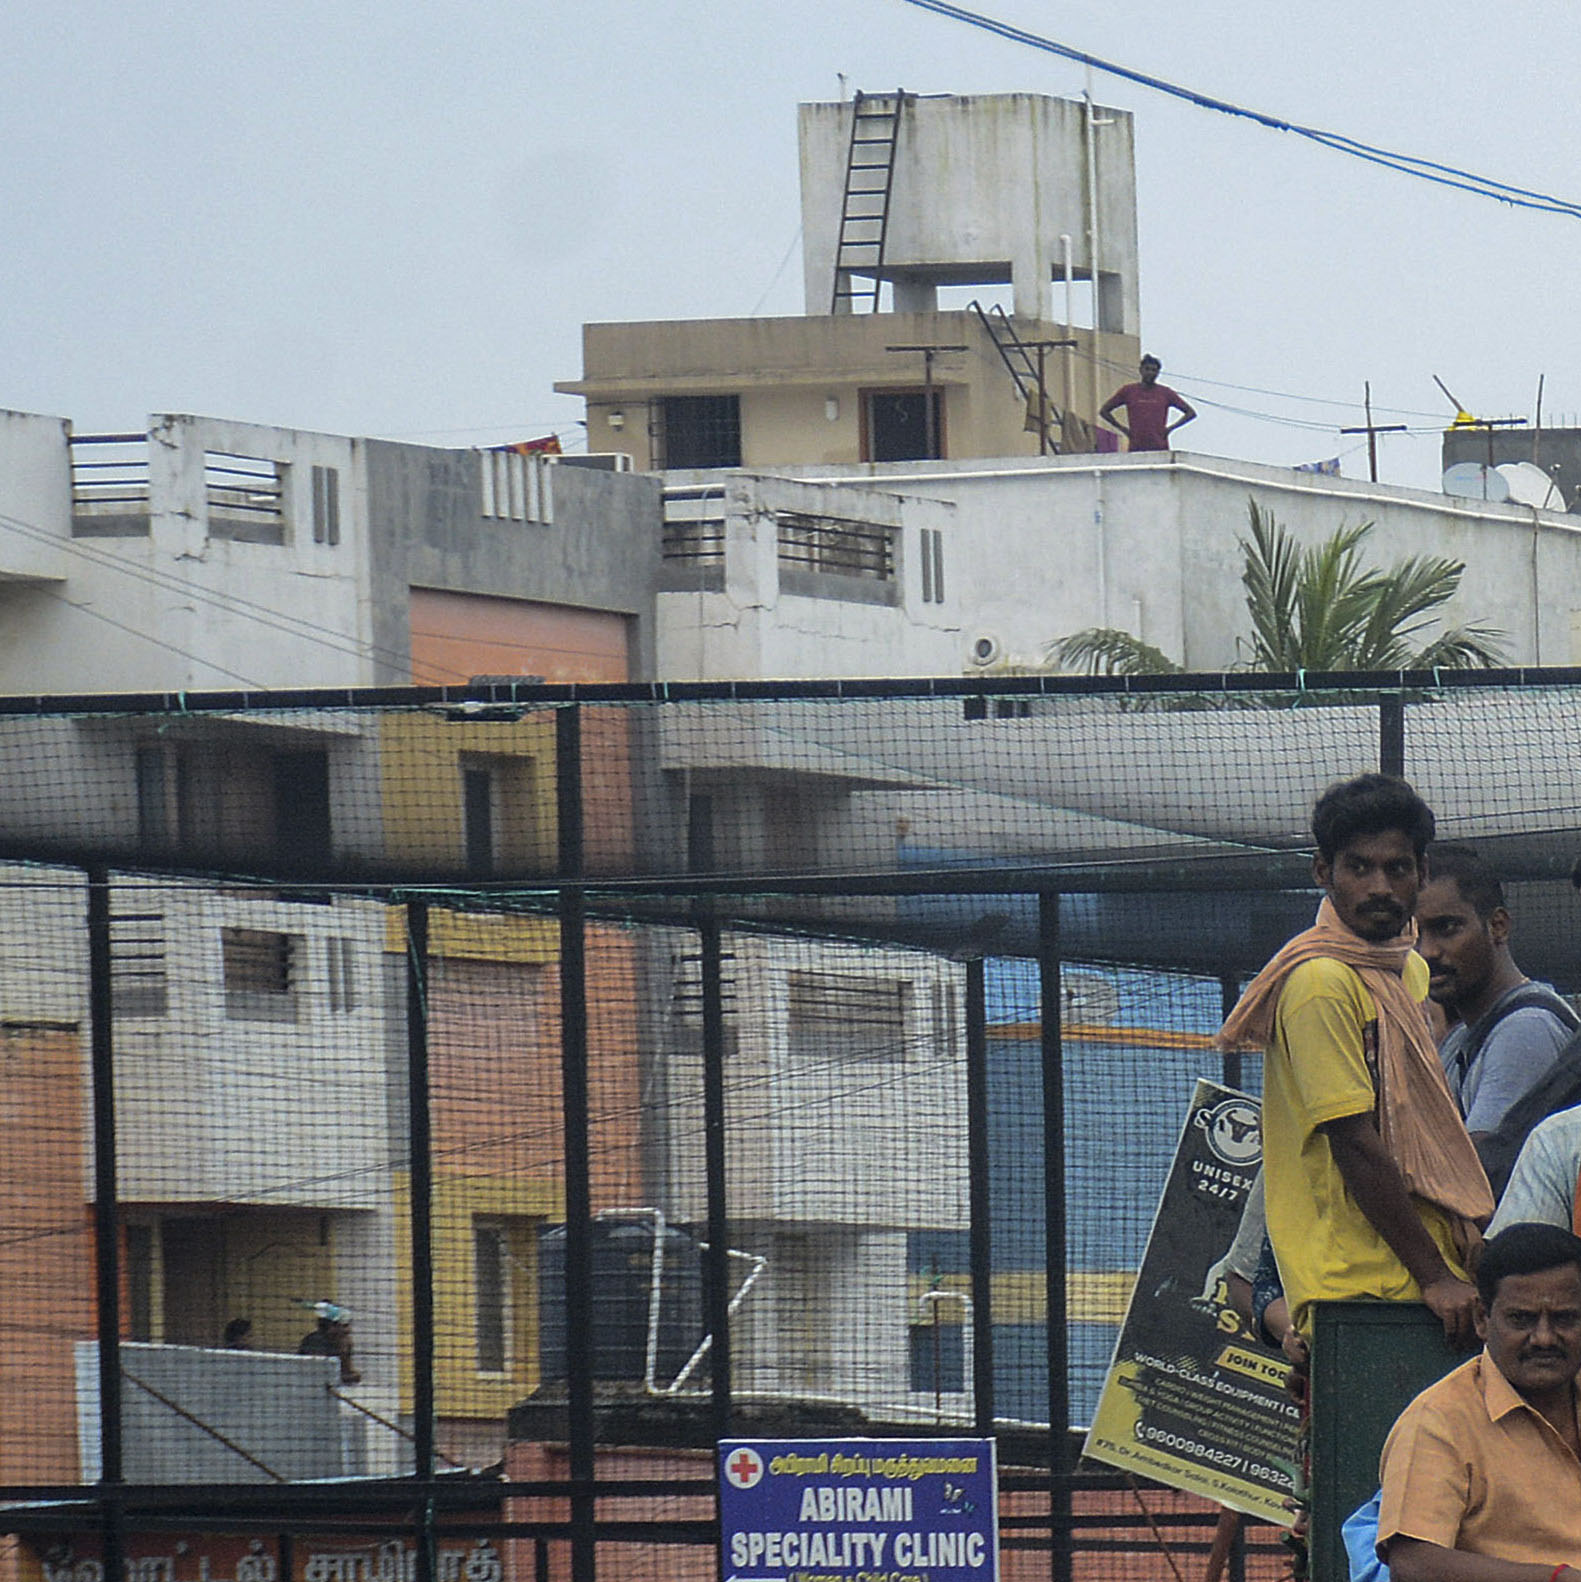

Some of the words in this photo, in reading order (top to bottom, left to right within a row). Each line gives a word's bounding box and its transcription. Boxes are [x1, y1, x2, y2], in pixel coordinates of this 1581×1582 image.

[1192, 1160, 1253, 1190] UNISEX
[1198, 1180, 1238, 1201] 24/7
[1226, 1352, 1258, 1372] JOIN
[1133, 1352, 1216, 1389] WORLD-CLASS
[1214, 1381, 1281, 1412] EQUIPMENT
[1145, 1426, 1241, 1470] 9600984227
[799, 1487, 913, 1521] ABIRAMI
[731, 1532, 887, 1567] SPECIALITY
[894, 1532, 985, 1567] CLINIC
